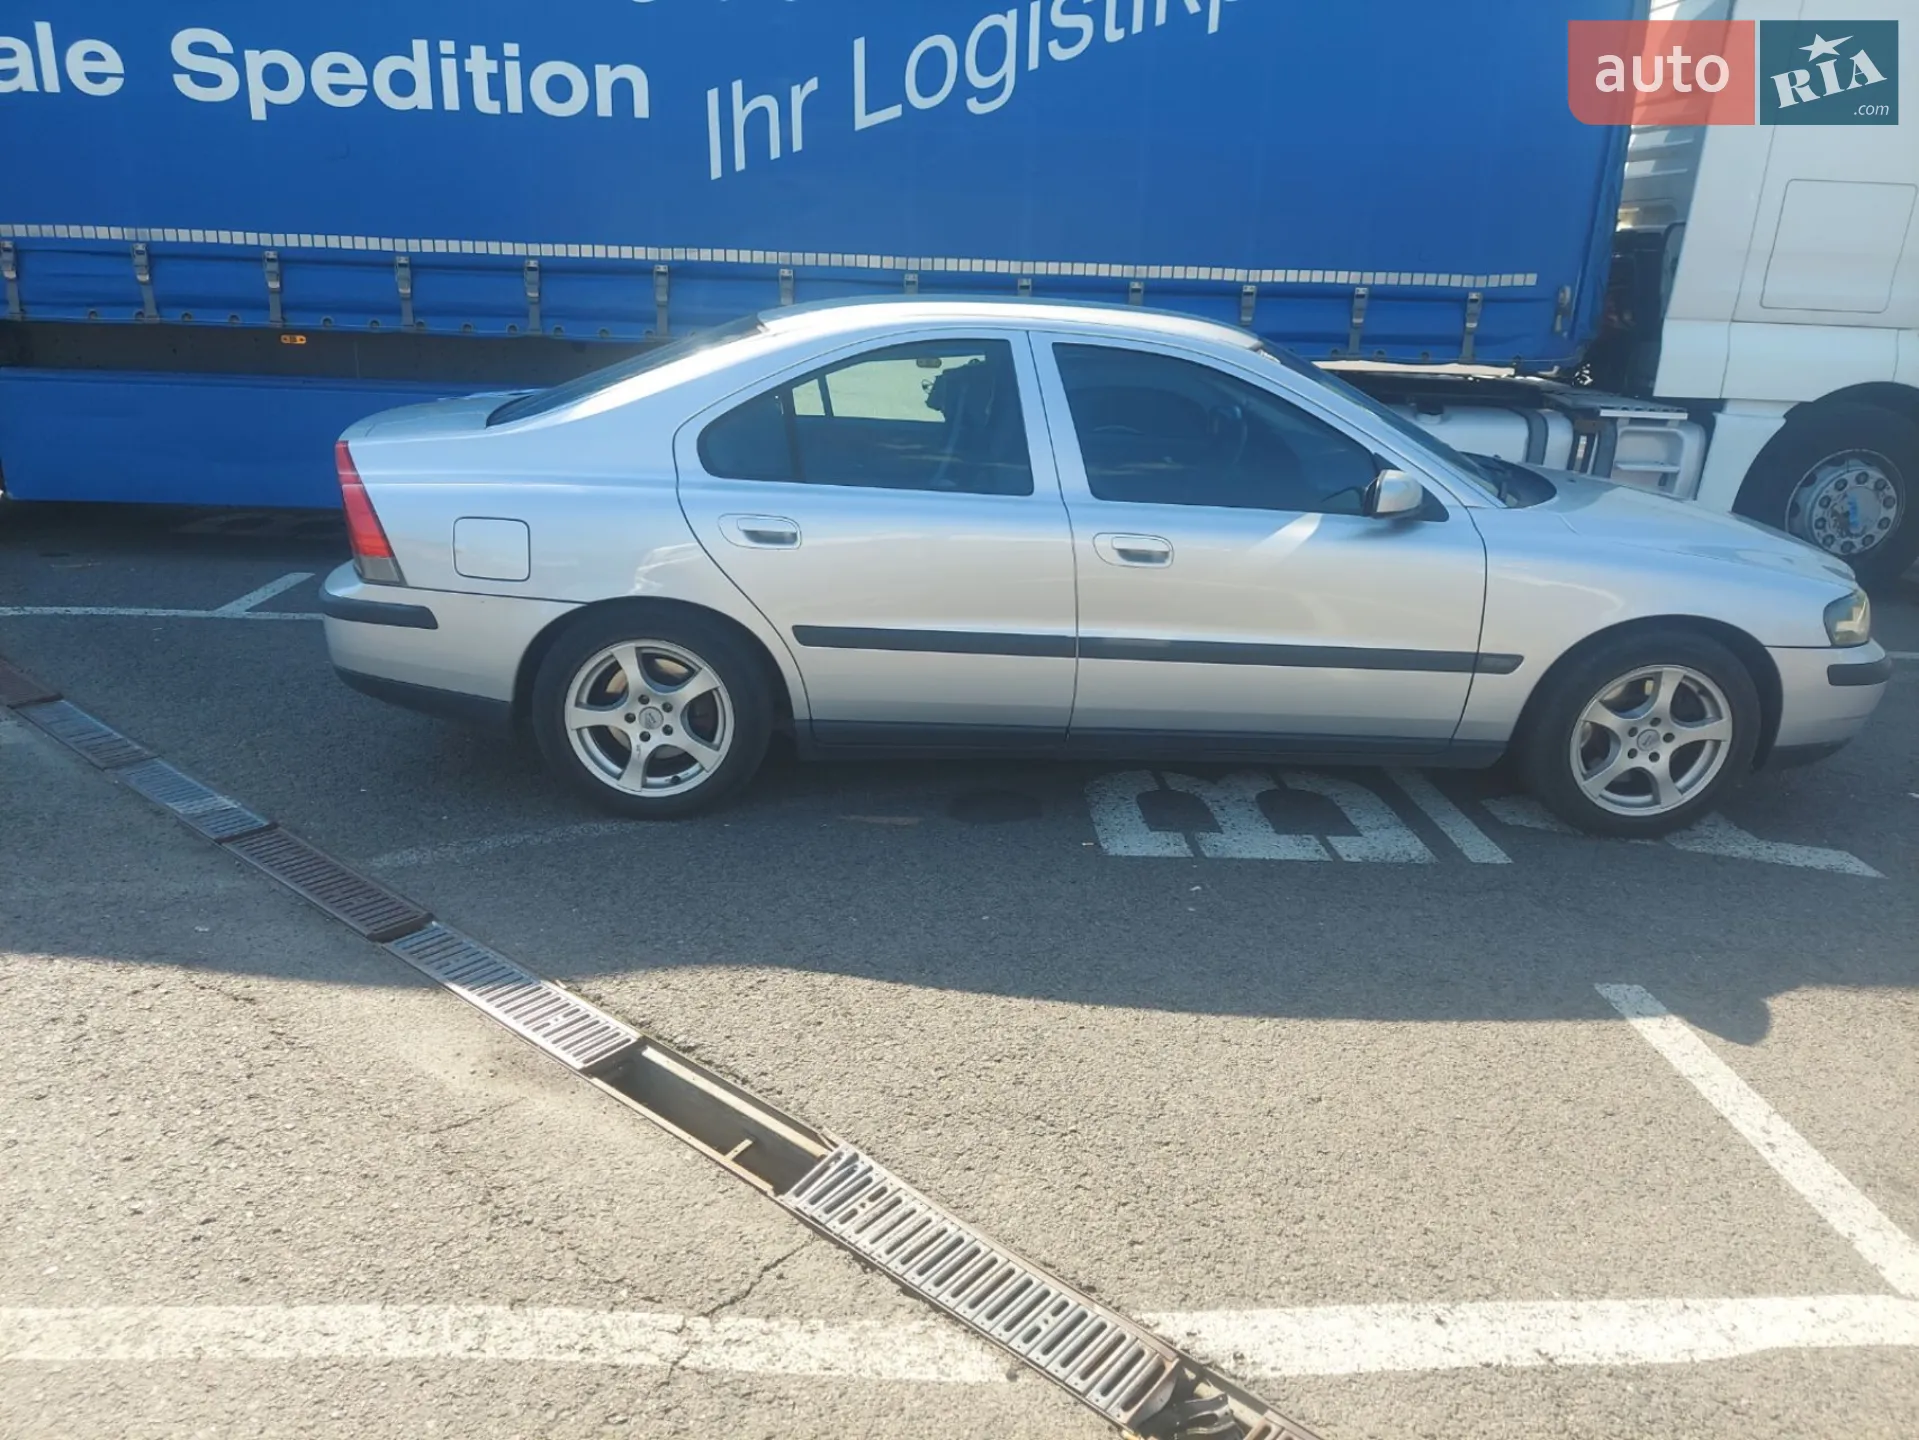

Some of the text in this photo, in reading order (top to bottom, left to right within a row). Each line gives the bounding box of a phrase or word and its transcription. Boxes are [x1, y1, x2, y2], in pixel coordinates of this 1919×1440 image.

[170, 27, 650, 121] Spedition
[708, 0, 1238, 180] Ihr Logis
